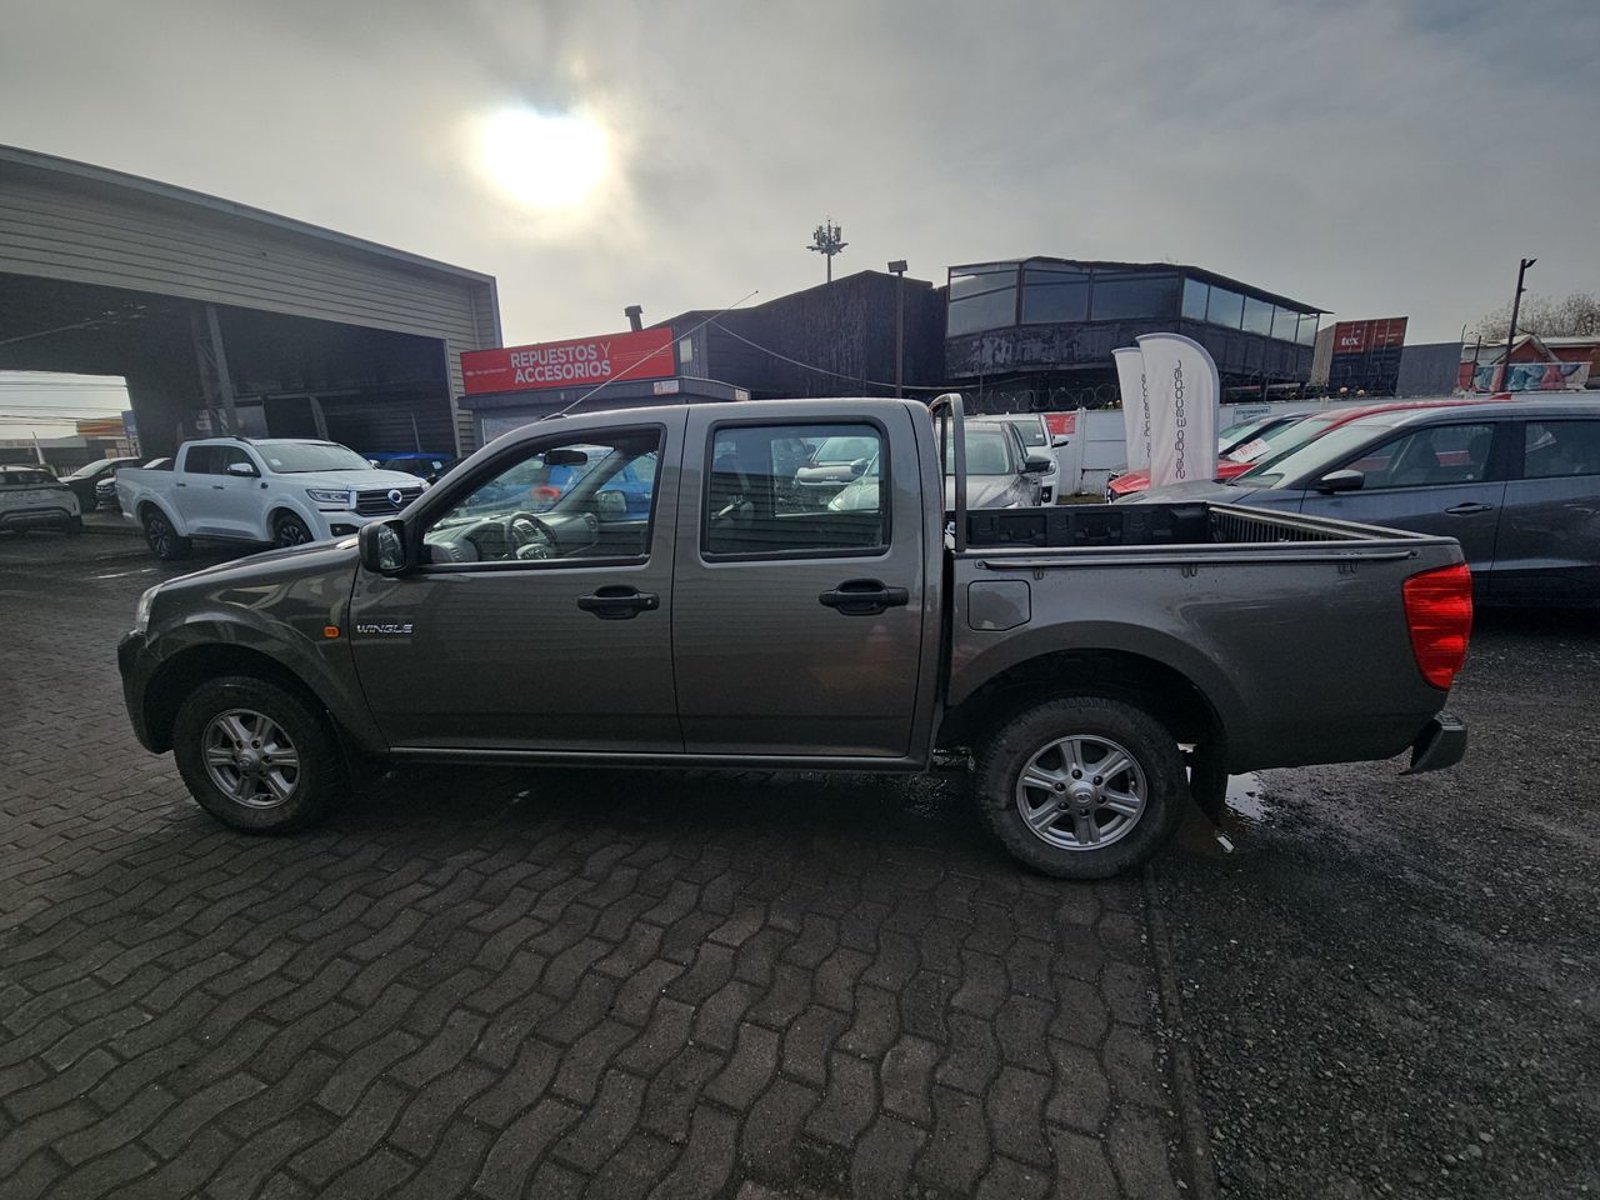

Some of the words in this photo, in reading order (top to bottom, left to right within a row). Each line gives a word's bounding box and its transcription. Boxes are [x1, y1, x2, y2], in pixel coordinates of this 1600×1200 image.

[510, 344, 597, 368] REPUESTOS
[600, 342, 611, 358] Y
[515, 360, 612, 384] ACCESORIOS
[357, 625, 413, 633] WINGLE
